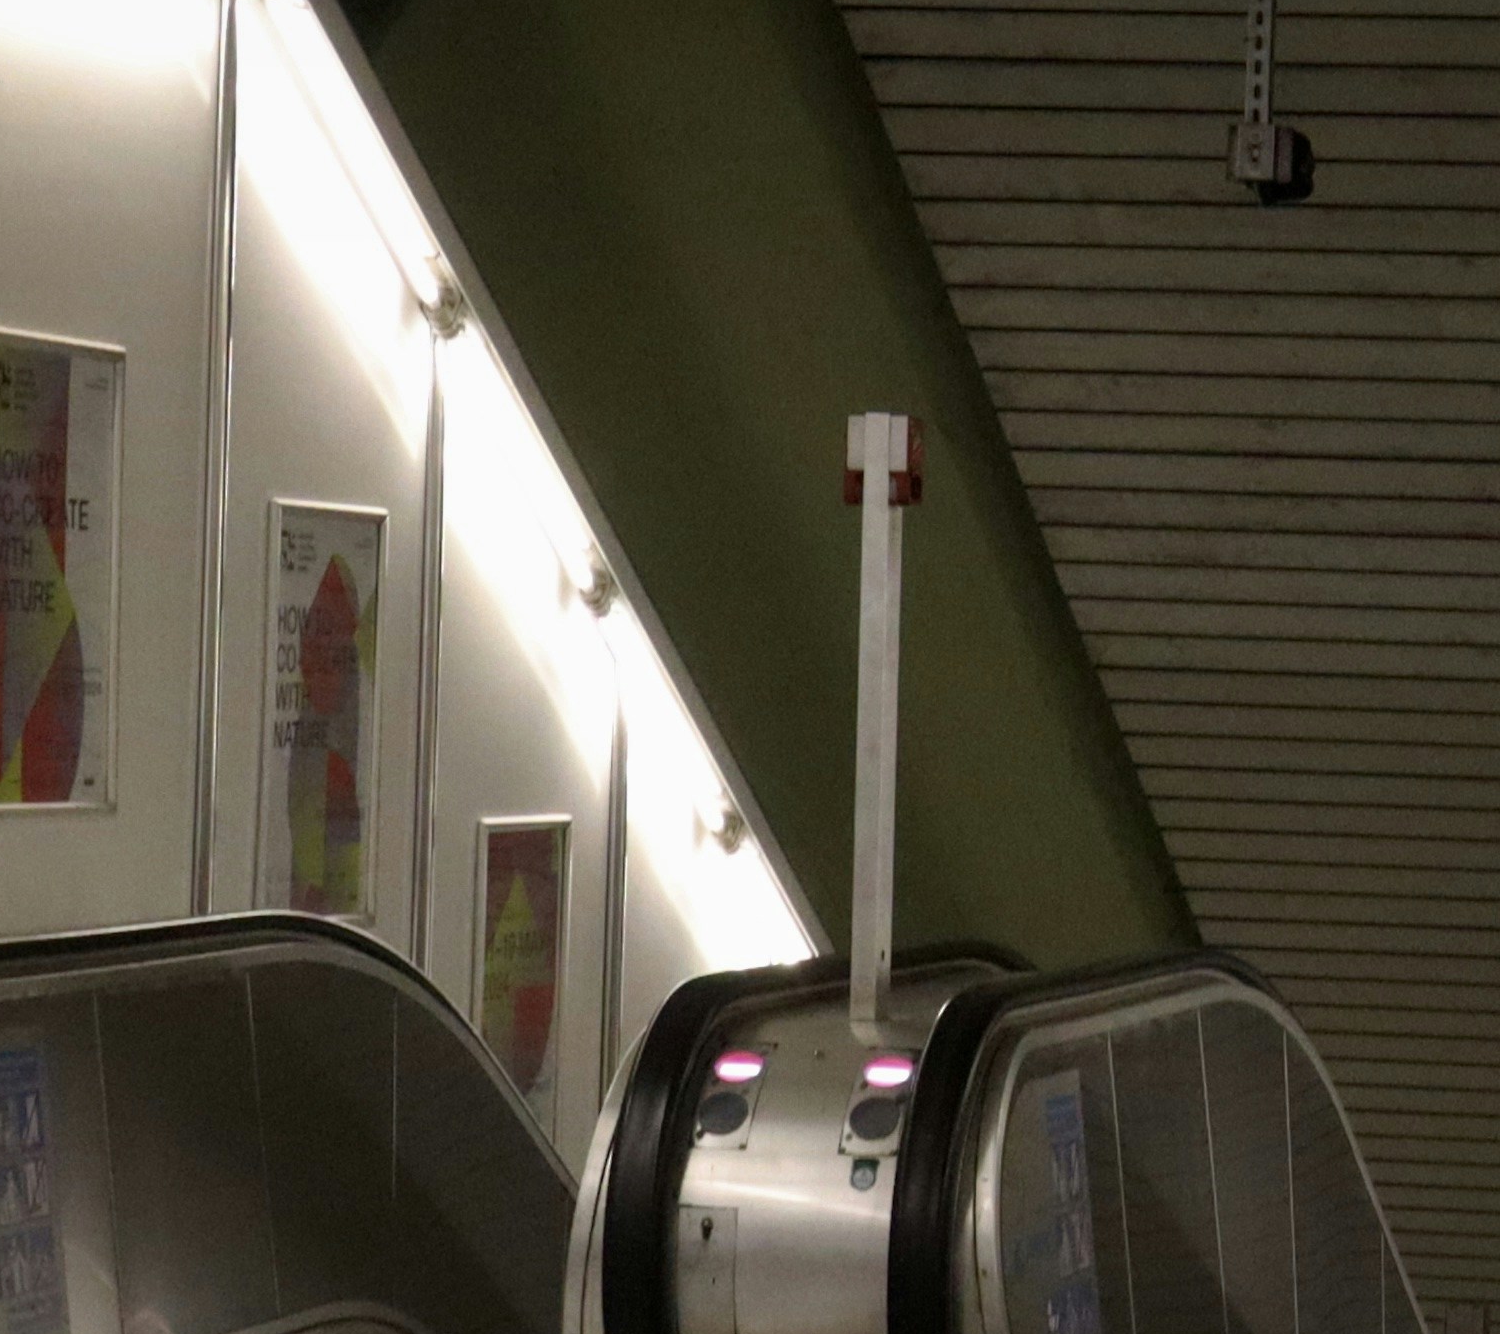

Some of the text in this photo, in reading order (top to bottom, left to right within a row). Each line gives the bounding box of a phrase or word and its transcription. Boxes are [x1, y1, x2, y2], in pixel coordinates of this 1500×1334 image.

[35, 451, 59, 484] TO
[277, 604, 310, 636] HOW
[275, 681, 311, 713] WITH
[273, 720, 330, 751] NATURE
